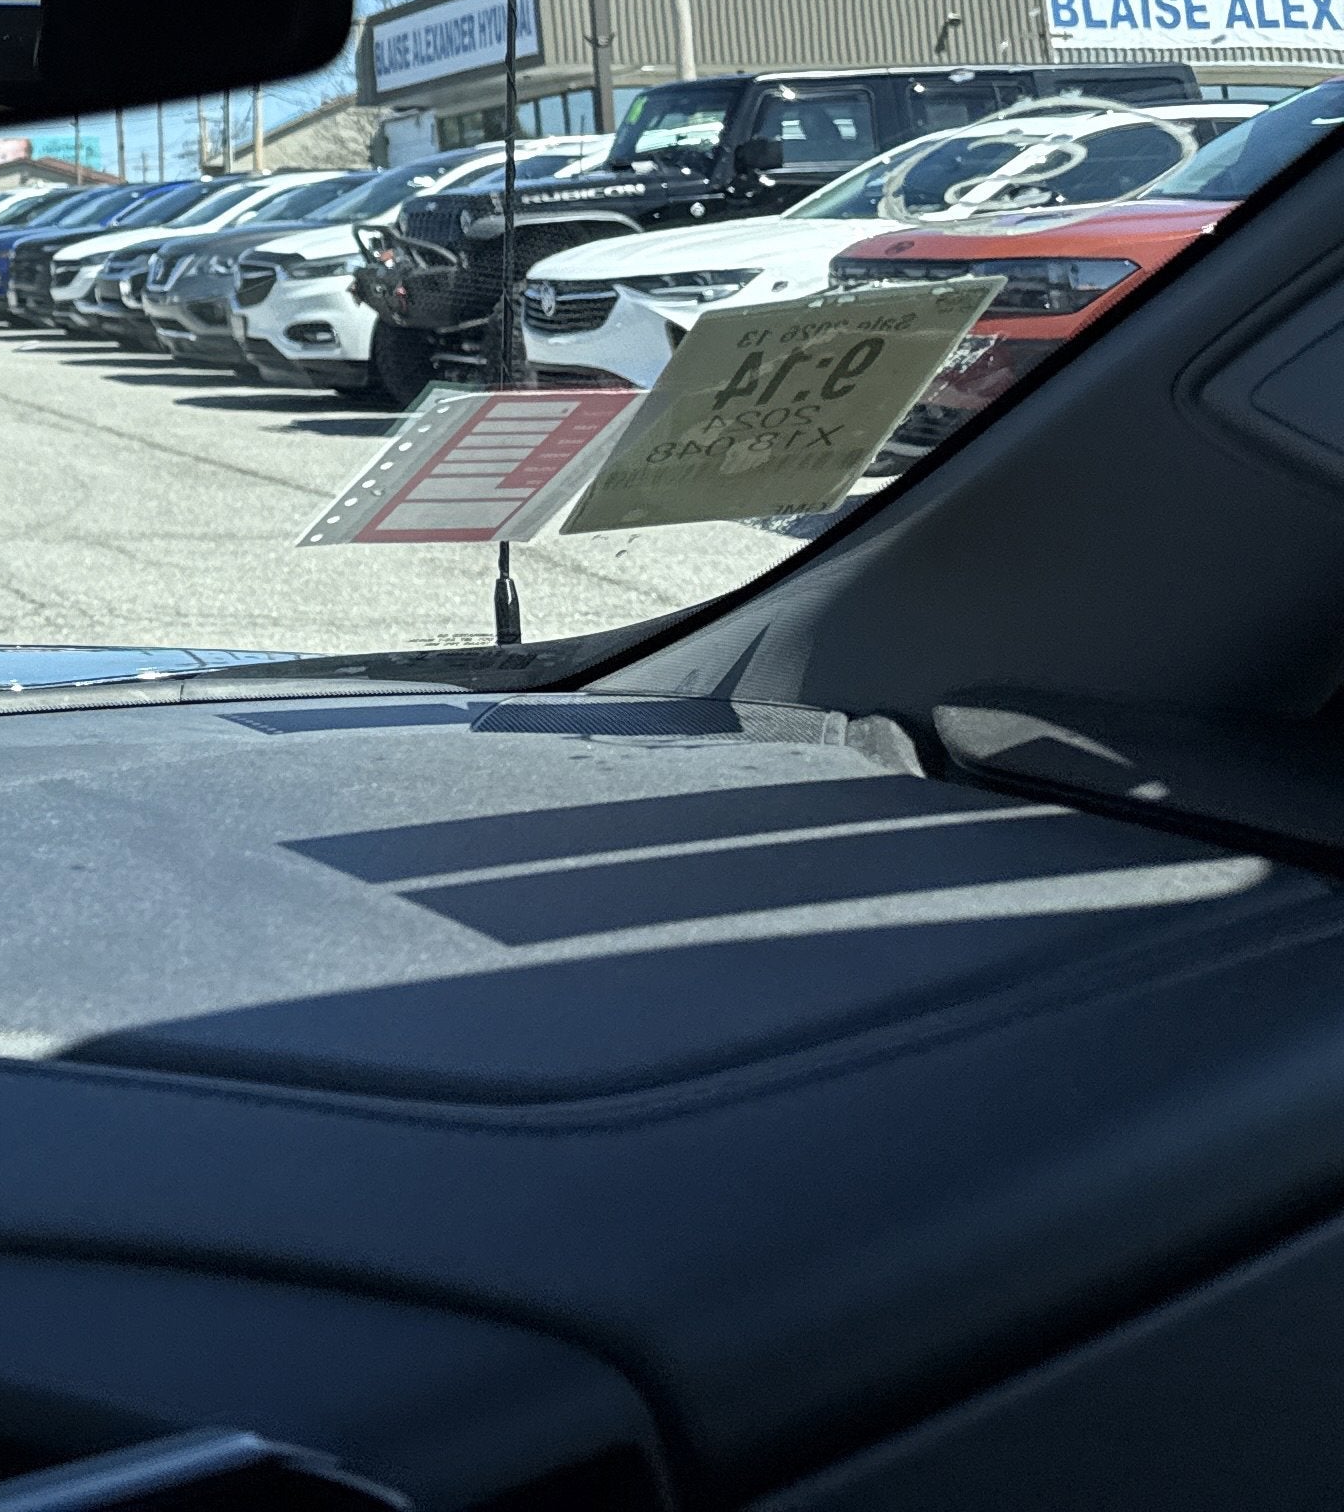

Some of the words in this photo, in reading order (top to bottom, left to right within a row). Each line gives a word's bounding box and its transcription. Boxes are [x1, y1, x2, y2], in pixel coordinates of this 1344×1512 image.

[375, 32, 411, 77] BLAISE
[412, 14, 477, 67] ALEXANDER
[521, 183, 646, 205] RUBICON
